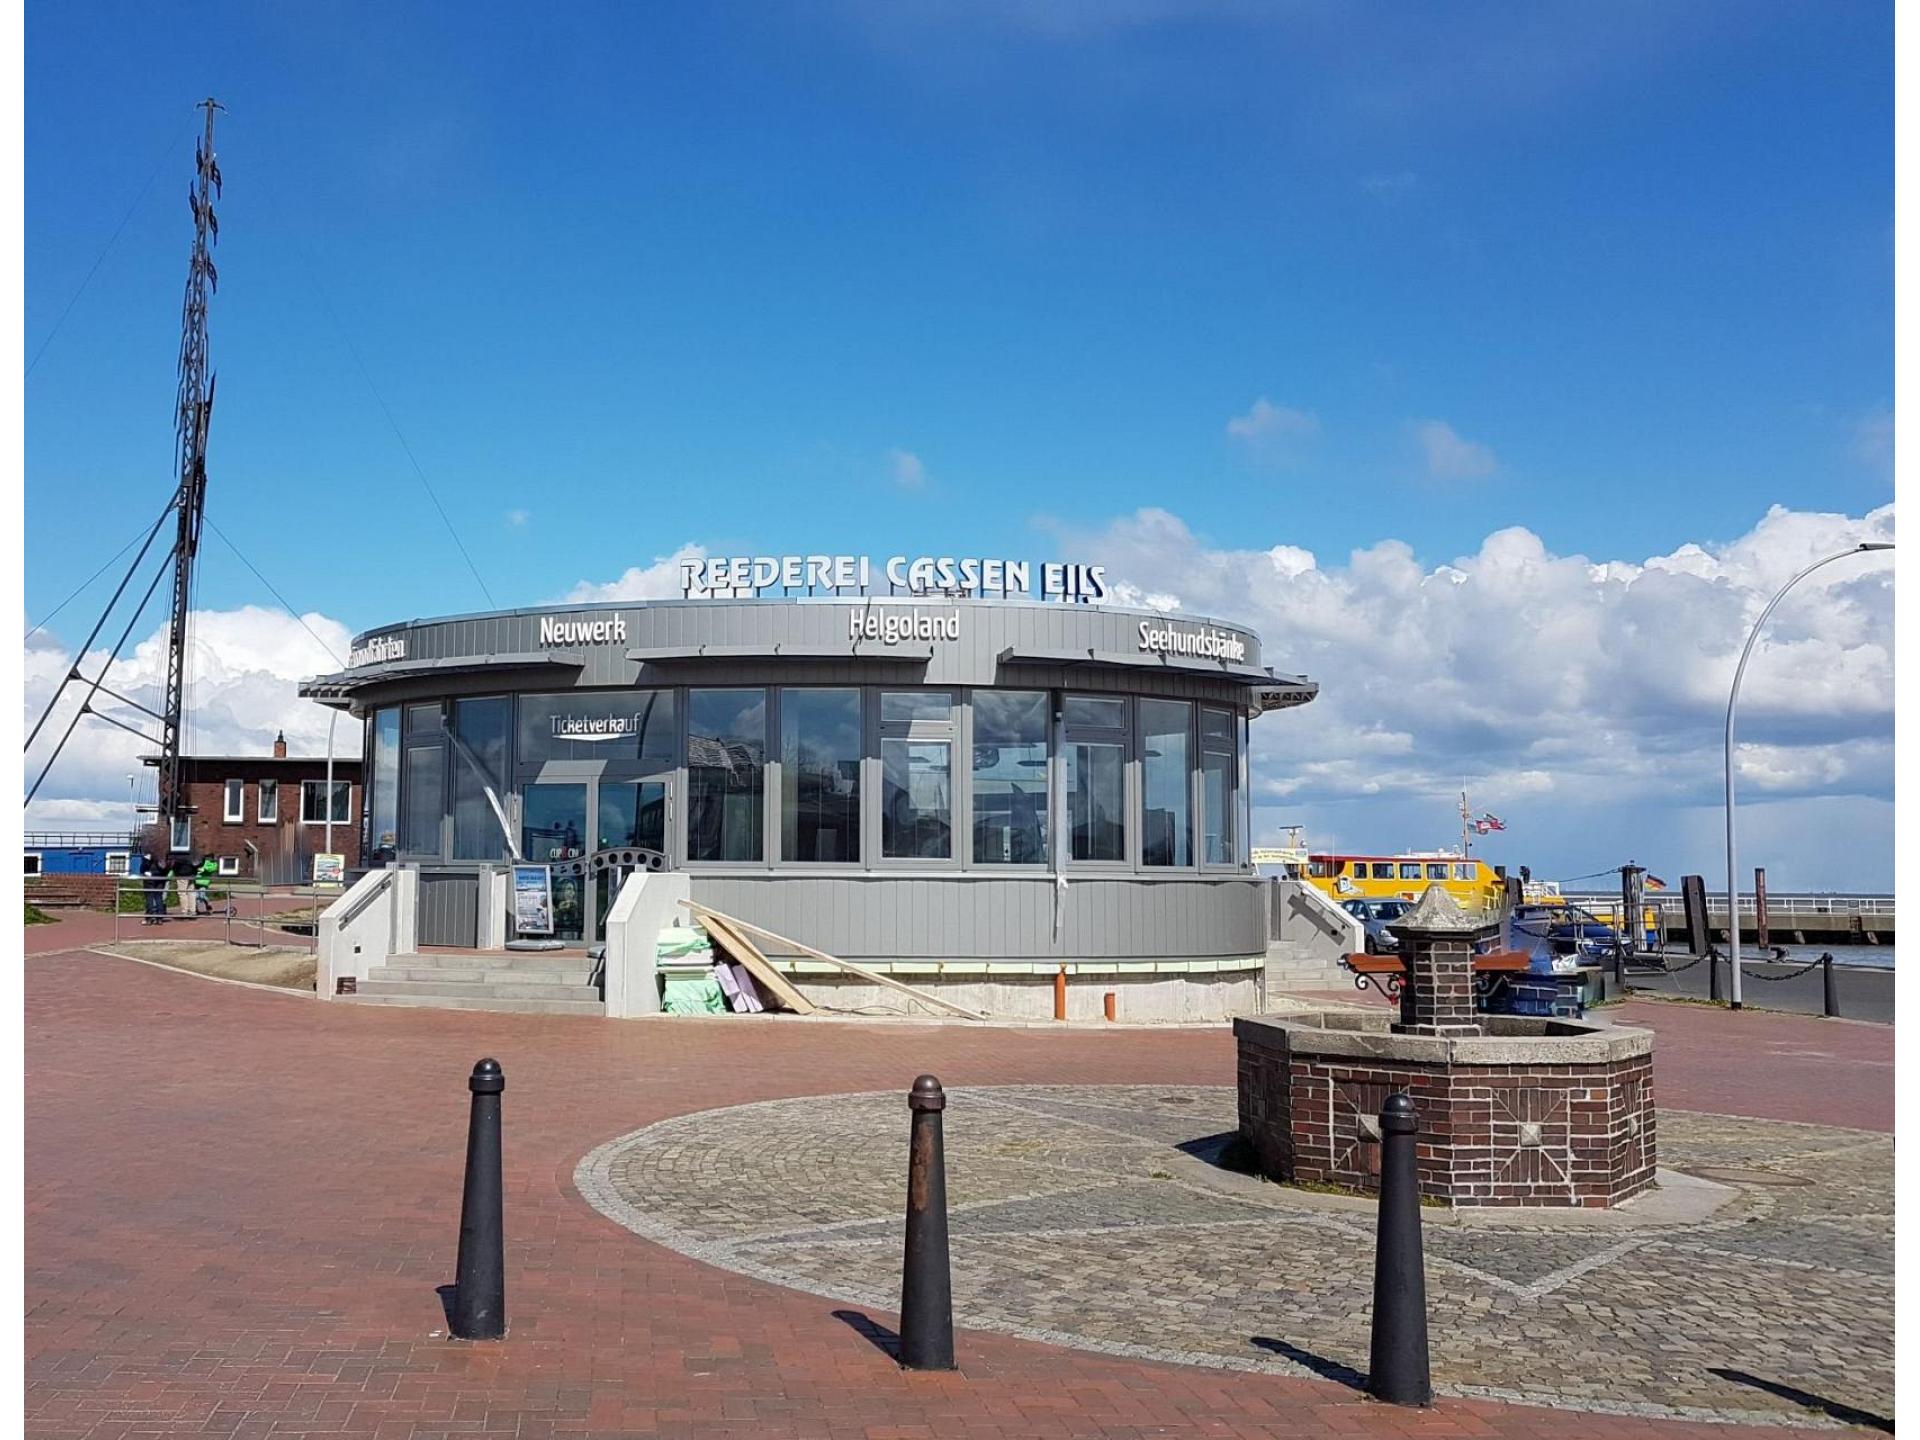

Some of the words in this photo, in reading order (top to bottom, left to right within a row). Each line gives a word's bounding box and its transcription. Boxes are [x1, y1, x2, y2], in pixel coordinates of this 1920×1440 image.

[680, 555, 869, 593] REEDEREI
[886, 556, 1030, 593] CASSEN
[1040, 562, 1106, 604] EILS
[540, 612, 626, 645] Neuwerk
[849, 607, 960, 645] Helgoland
[1139, 621, 1245, 662] Seehundsbänke
[550, 712, 641, 734] Ticketverkauf
